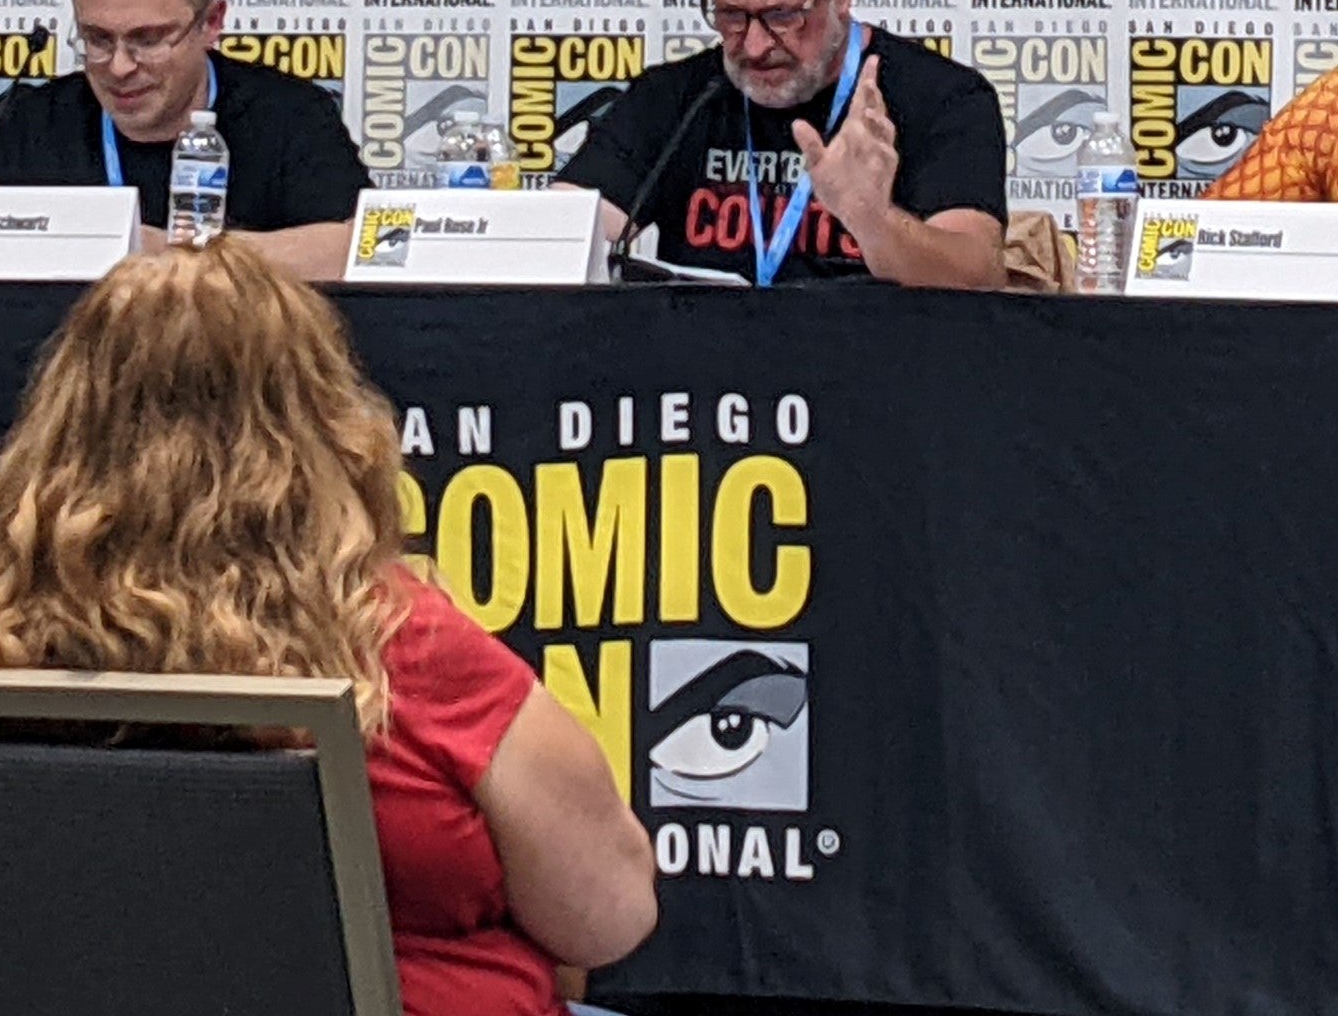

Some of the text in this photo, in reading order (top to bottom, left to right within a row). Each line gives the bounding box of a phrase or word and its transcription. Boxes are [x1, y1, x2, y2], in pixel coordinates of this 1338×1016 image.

[380, 210, 415, 226] CON
[414, 217, 443, 233] Paul
[476, 217, 489, 234] Jr
[1161, 220, 1197, 239] CON
[1197, 229, 1284, 248] Rick Stafford
[401, 393, 811, 455] AN DIEGO
